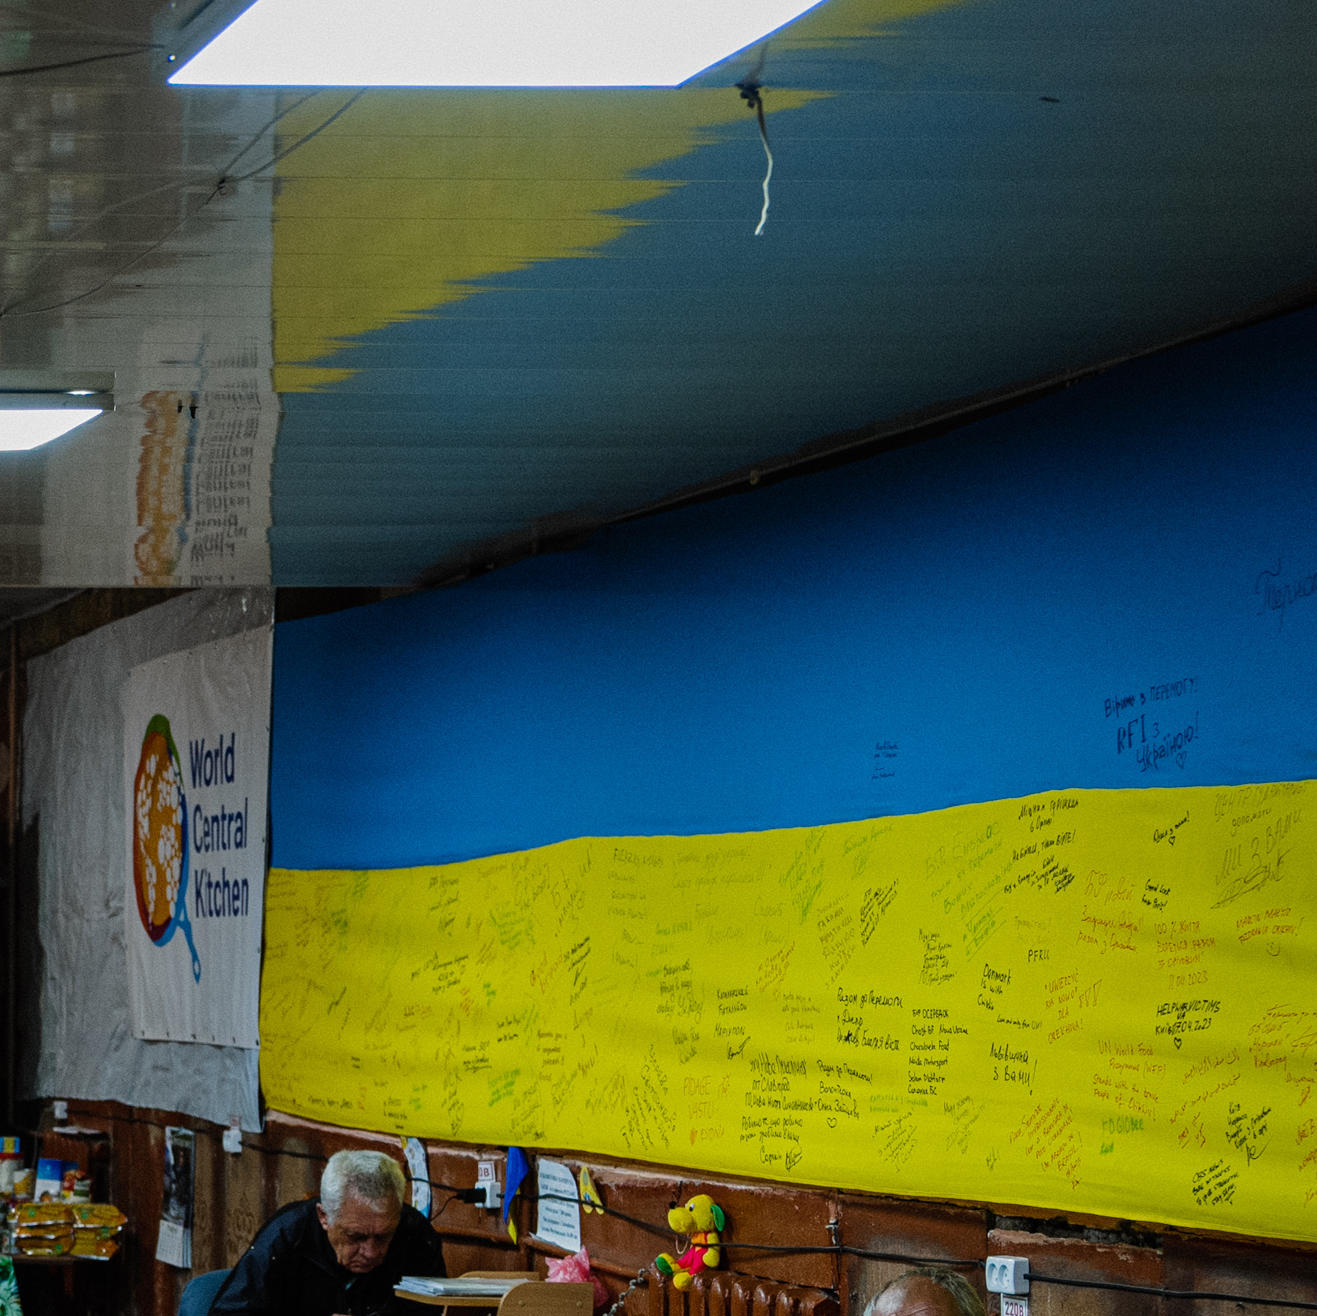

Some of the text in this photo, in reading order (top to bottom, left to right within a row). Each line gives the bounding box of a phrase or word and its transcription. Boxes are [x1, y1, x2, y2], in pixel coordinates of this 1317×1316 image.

[189, 732, 235, 789] World
[1117, 714, 1147, 754] RFI
[1136, 711, 1199, 773] Україною!
[193, 797, 248, 853] Central
[194, 866, 249, 919] Kitchen
